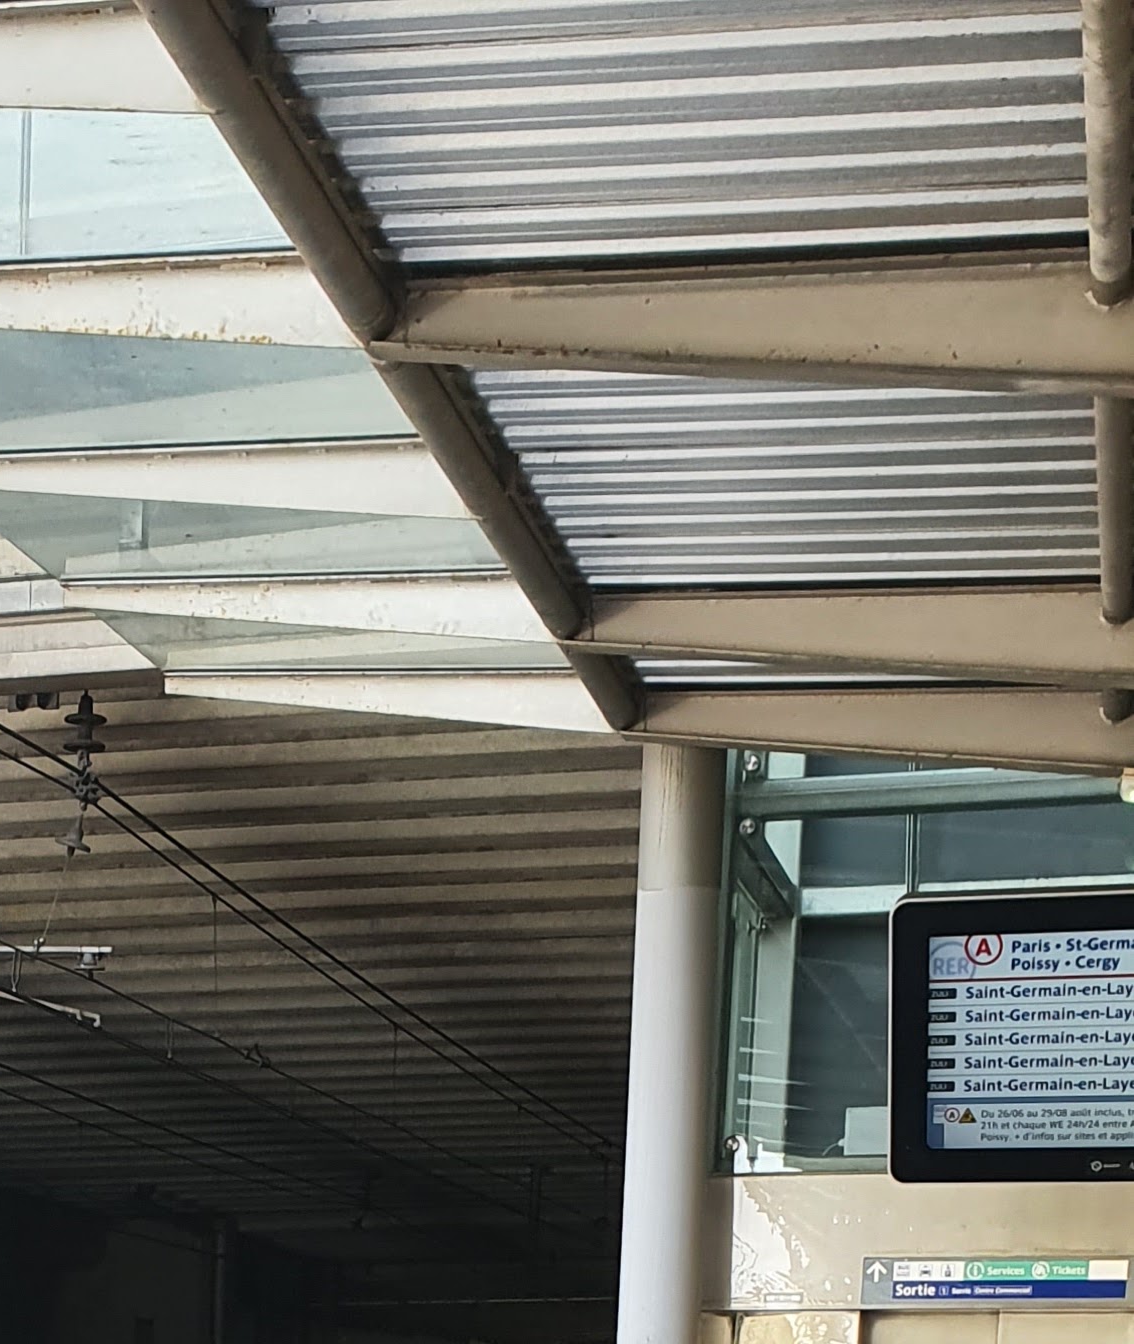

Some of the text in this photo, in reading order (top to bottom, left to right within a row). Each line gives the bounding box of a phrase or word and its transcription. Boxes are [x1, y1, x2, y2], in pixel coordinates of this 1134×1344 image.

[975, 938, 992, 956] A
[1011, 939, 1051, 953] Paris
[932, 957, 969, 975] RER
[1011, 955, 1121, 973] Poissy Cergy
[965, 1007, 1134, 1023] Saint-Germain-en-Lay
[981, 1109, 995, 1118] Du
[1027, 1110, 1038, 1118] au
[981, 1121, 998, 1130] 21h
[1000, 1121, 1010, 1129] et
[1012, 1121, 1047, 1131] chaque
[1049, 1120, 1064, 1129] WE
[1102, 1120, 1127, 1128] entre
[1057, 1133, 1072, 1141] sur
[1097, 1132, 1107, 1140] et
[987, 1265, 1086, 1276] Services Tickets
[895, 1283, 936, 1297] Sortie
